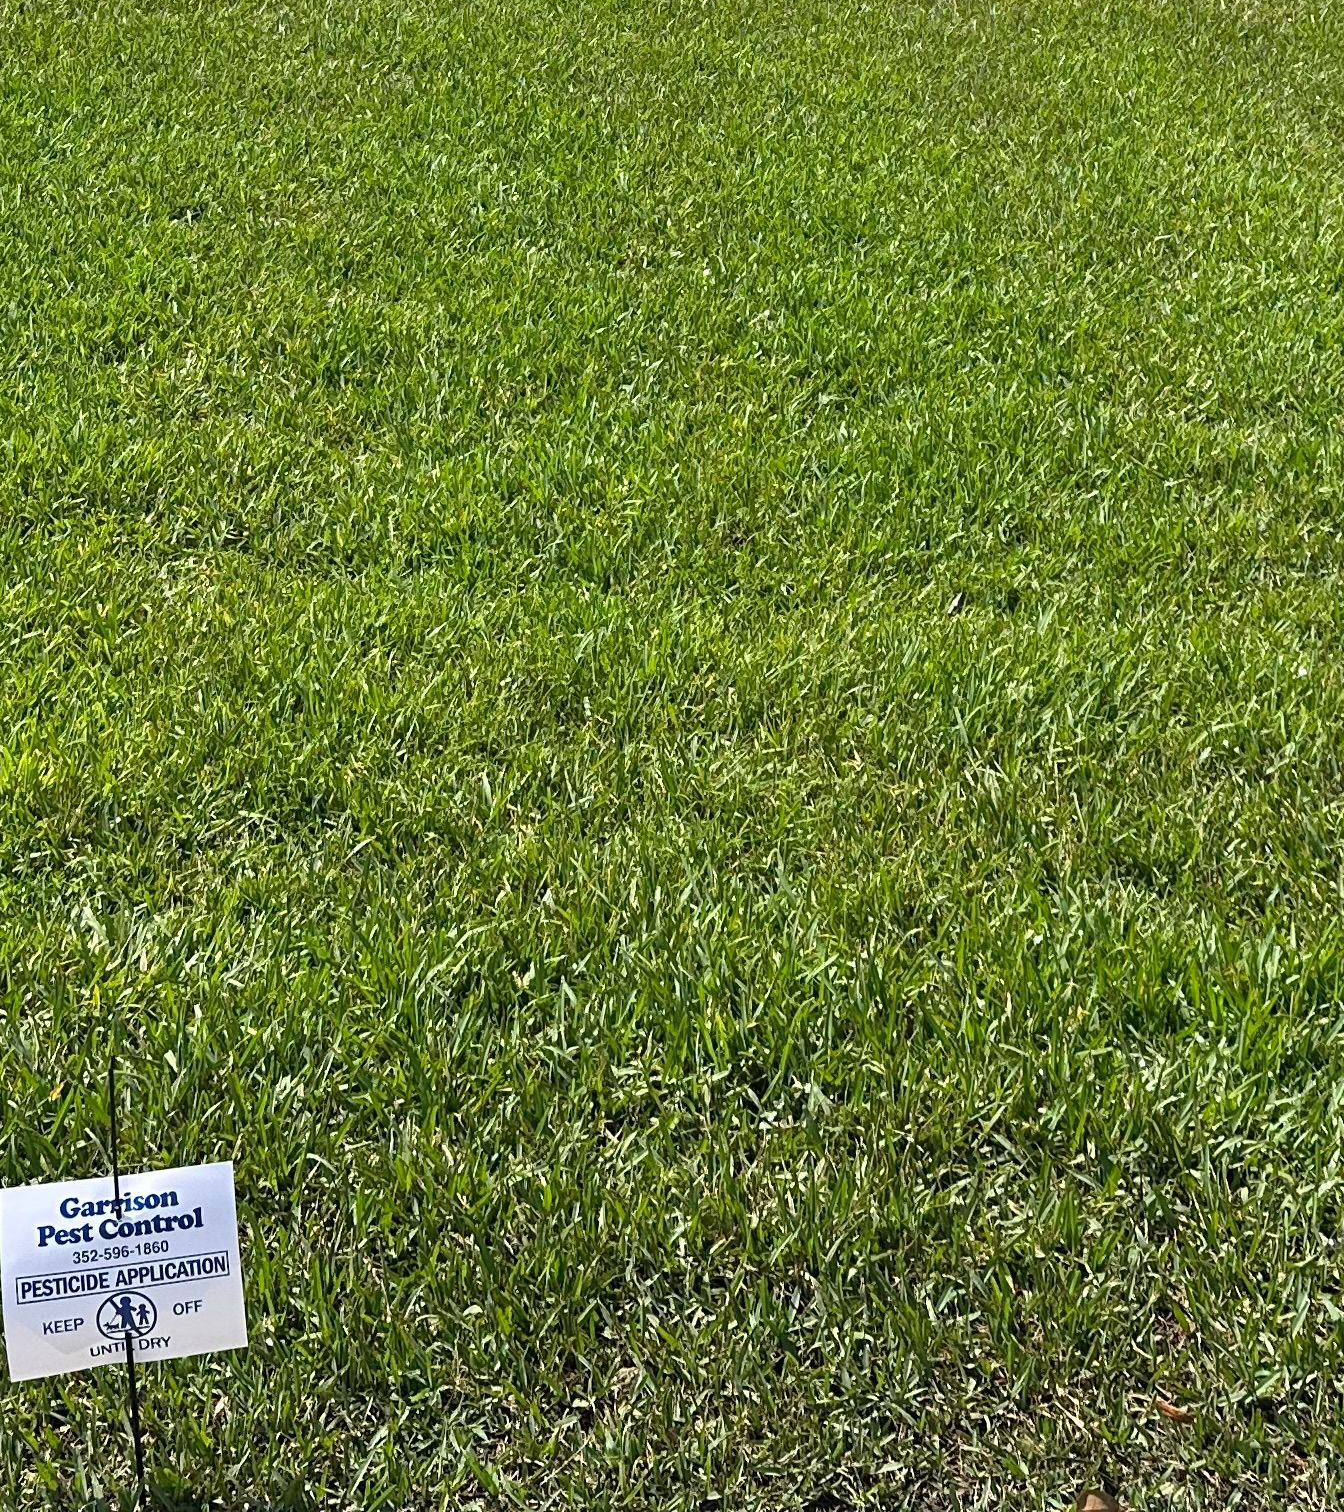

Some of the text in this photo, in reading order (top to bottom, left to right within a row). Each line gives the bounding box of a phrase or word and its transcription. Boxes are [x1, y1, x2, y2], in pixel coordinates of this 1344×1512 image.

[60, 1190, 179, 1219] Garrison
[37, 1208, 204, 1247] Pest Control
[73, 1240, 169, 1264] 352-596-1860
[21, 1255, 226, 1299] PESTICIDE APPLICATION
[43, 1300, 203, 1335] KEEP OFF
[90, 1336, 171, 1357] UNTI DRY
